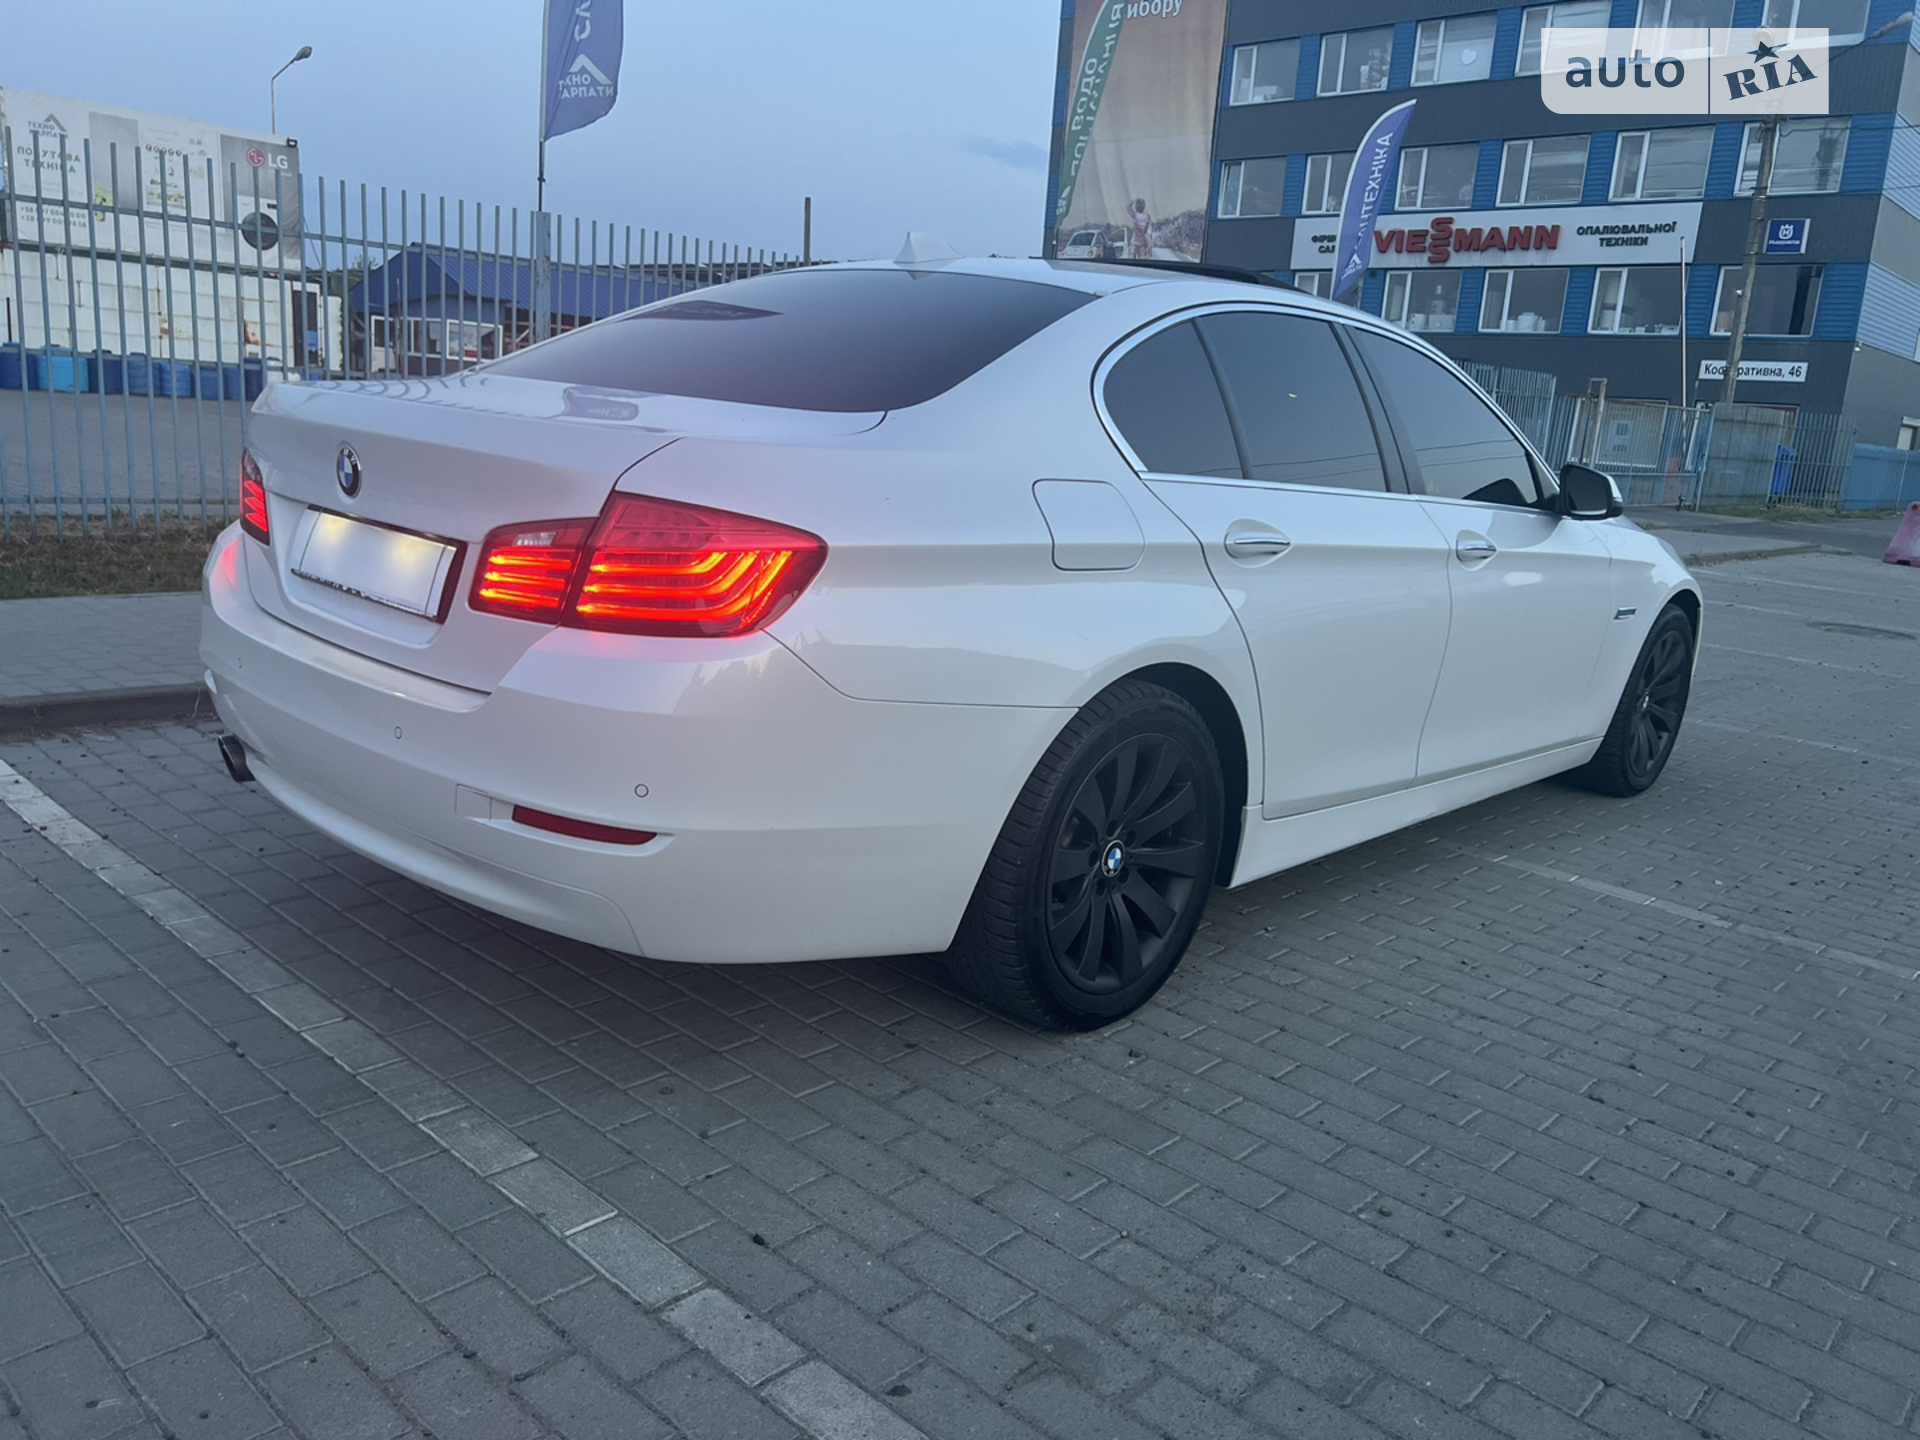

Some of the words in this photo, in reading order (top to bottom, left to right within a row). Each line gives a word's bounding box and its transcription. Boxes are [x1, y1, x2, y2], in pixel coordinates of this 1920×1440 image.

[1126, 0, 1182, 19] ибору
[558, 74, 591, 91] ТХНО
[559, 86, 614, 100] АРПАТИ
[1071, 58, 1098, 131] ВОДО
[17, 146, 81, 163] ПОУТВА
[268, 153, 288, 169] LG
[24, 158, 76, 173] ТЕХНІА
[1576, 221, 1678, 236] ОПАЛЮВАЛЬНОЇ
[1373, 216, 1560, 263] VIESSMANN
[1599, 236, 1649, 248] ТЕХНІКИ
[1704, 363, 1785, 378] Кооративна,
[1788, 365, 1802, 378] 46
